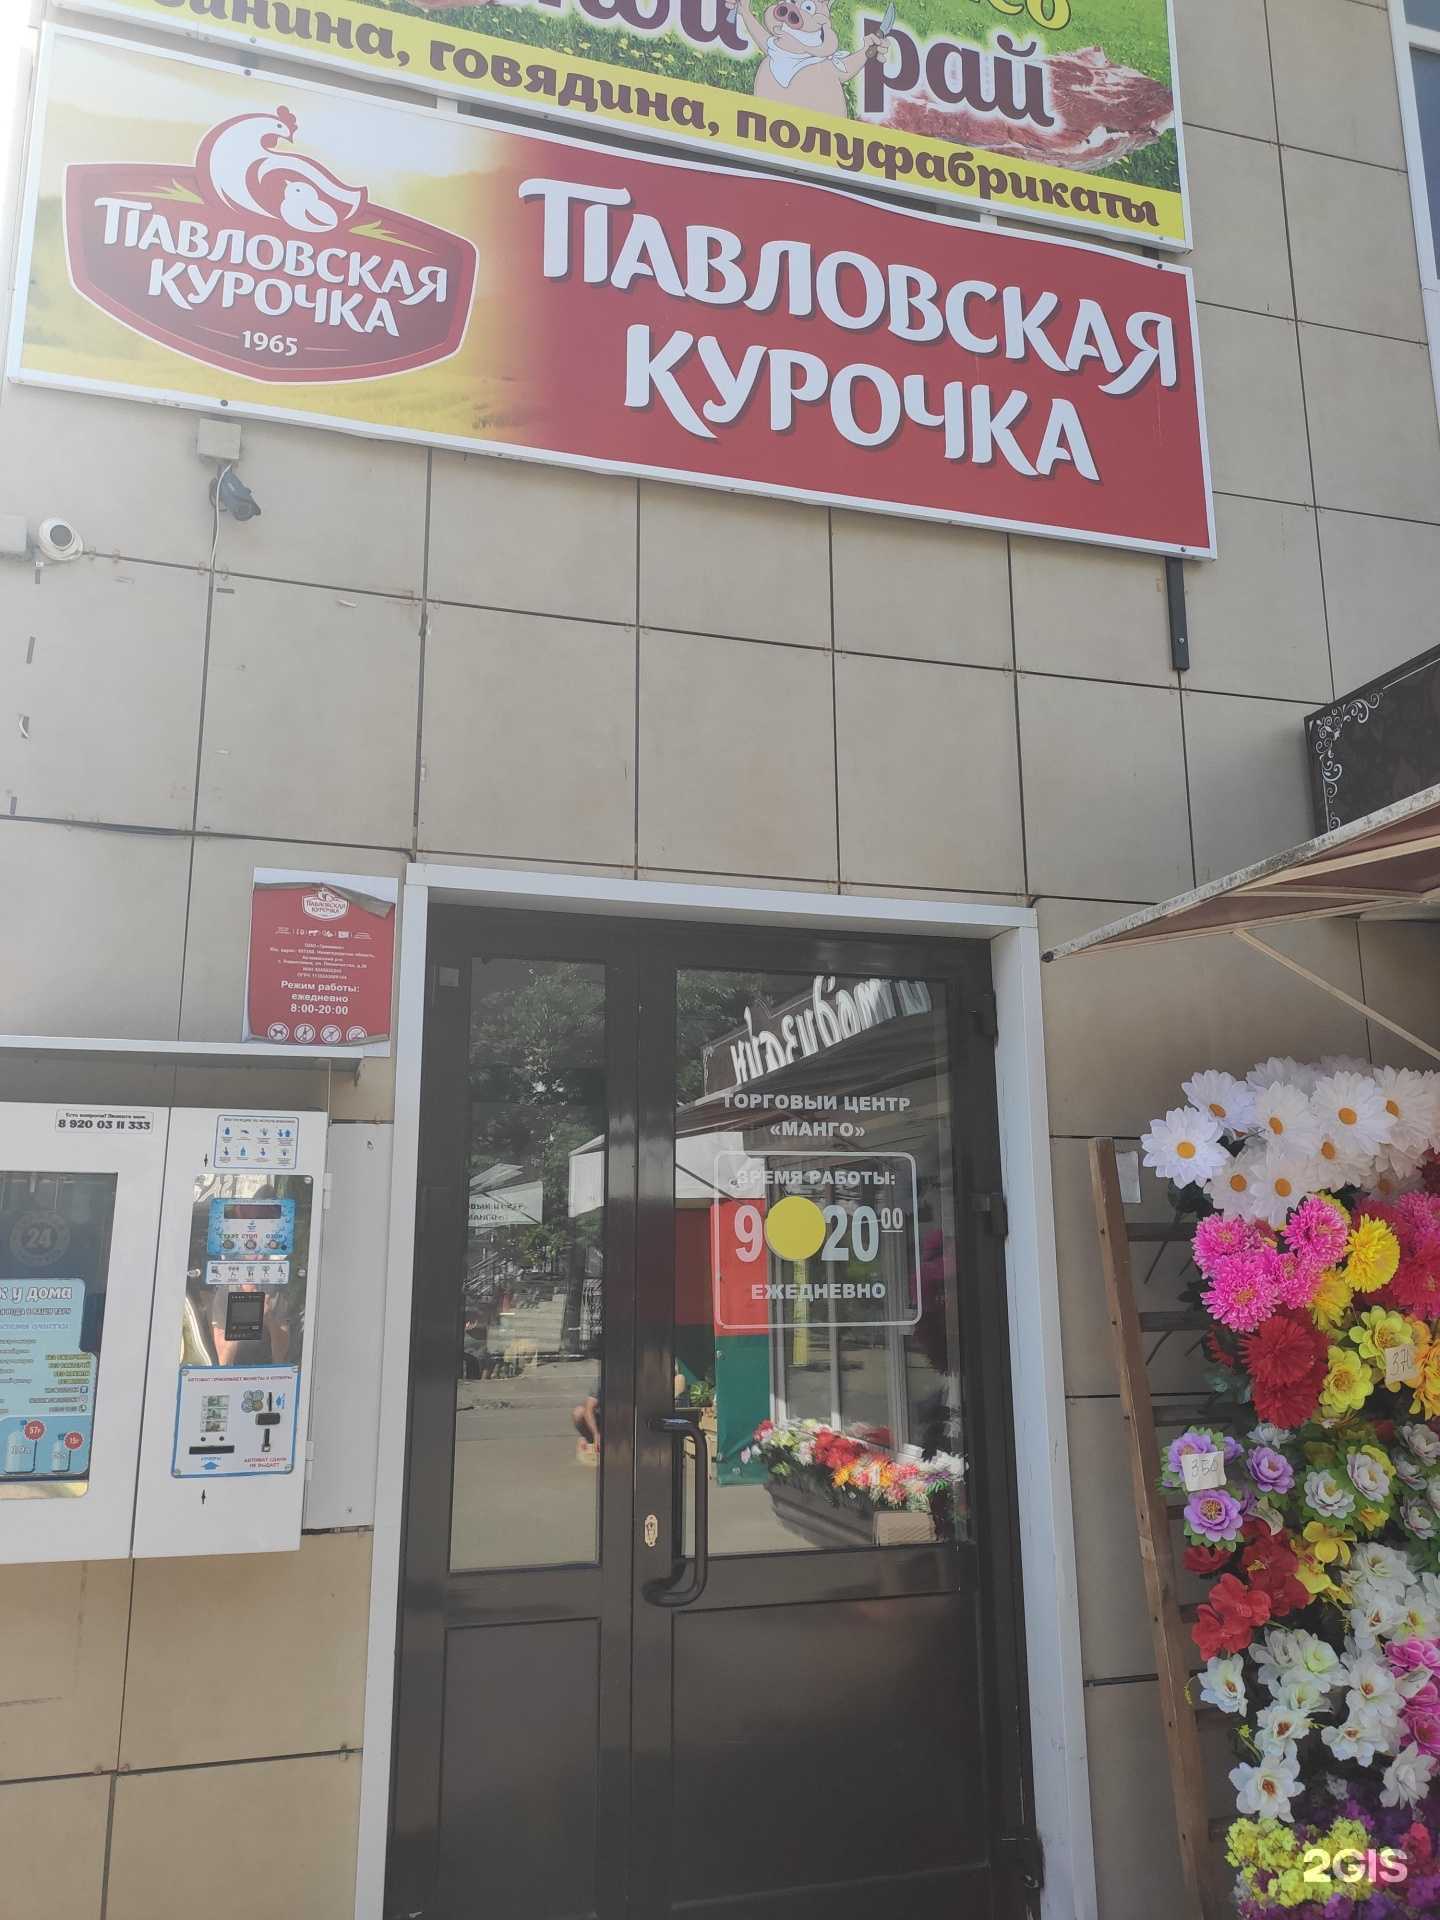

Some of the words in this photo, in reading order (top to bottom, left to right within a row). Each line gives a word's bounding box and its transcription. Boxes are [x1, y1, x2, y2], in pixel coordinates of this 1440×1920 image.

[864, 18, 1055, 128] рай
[429, 40, 720, 137] говядина,
[736, 109, 1160, 227] полуфабрикаты
[94, 197, 448, 306] ПАВЛОВСКАЯ
[517, 177, 1178, 395] ПАВЛОВСКАЯ
[147, 258, 401, 338] КУРОЧКА
[241, 330, 299, 356] 1965
[623, 323, 1101, 482] КУРОЧКА
[280, 980, 316, 990] Режим
[318, 983, 360, 993] работы:
[291, 993, 349, 1003] ежедневно
[290, 1003, 349, 1015] 8:00-20:00
[844, 1095, 911, 1114] ЦЕНТР
[58, 1119, 66, 1128] 8
[69, 1120, 93, 1129] 920
[96, 1120, 113, 1129] 03
[128, 1121, 151, 1130] 333
[770, 1121, 865, 1137] «МАНГО»
[809, 1170, 896, 1185] РАБОТЫ:
[751, 1283, 886, 1301] ЕЖЕДНЕВНО
